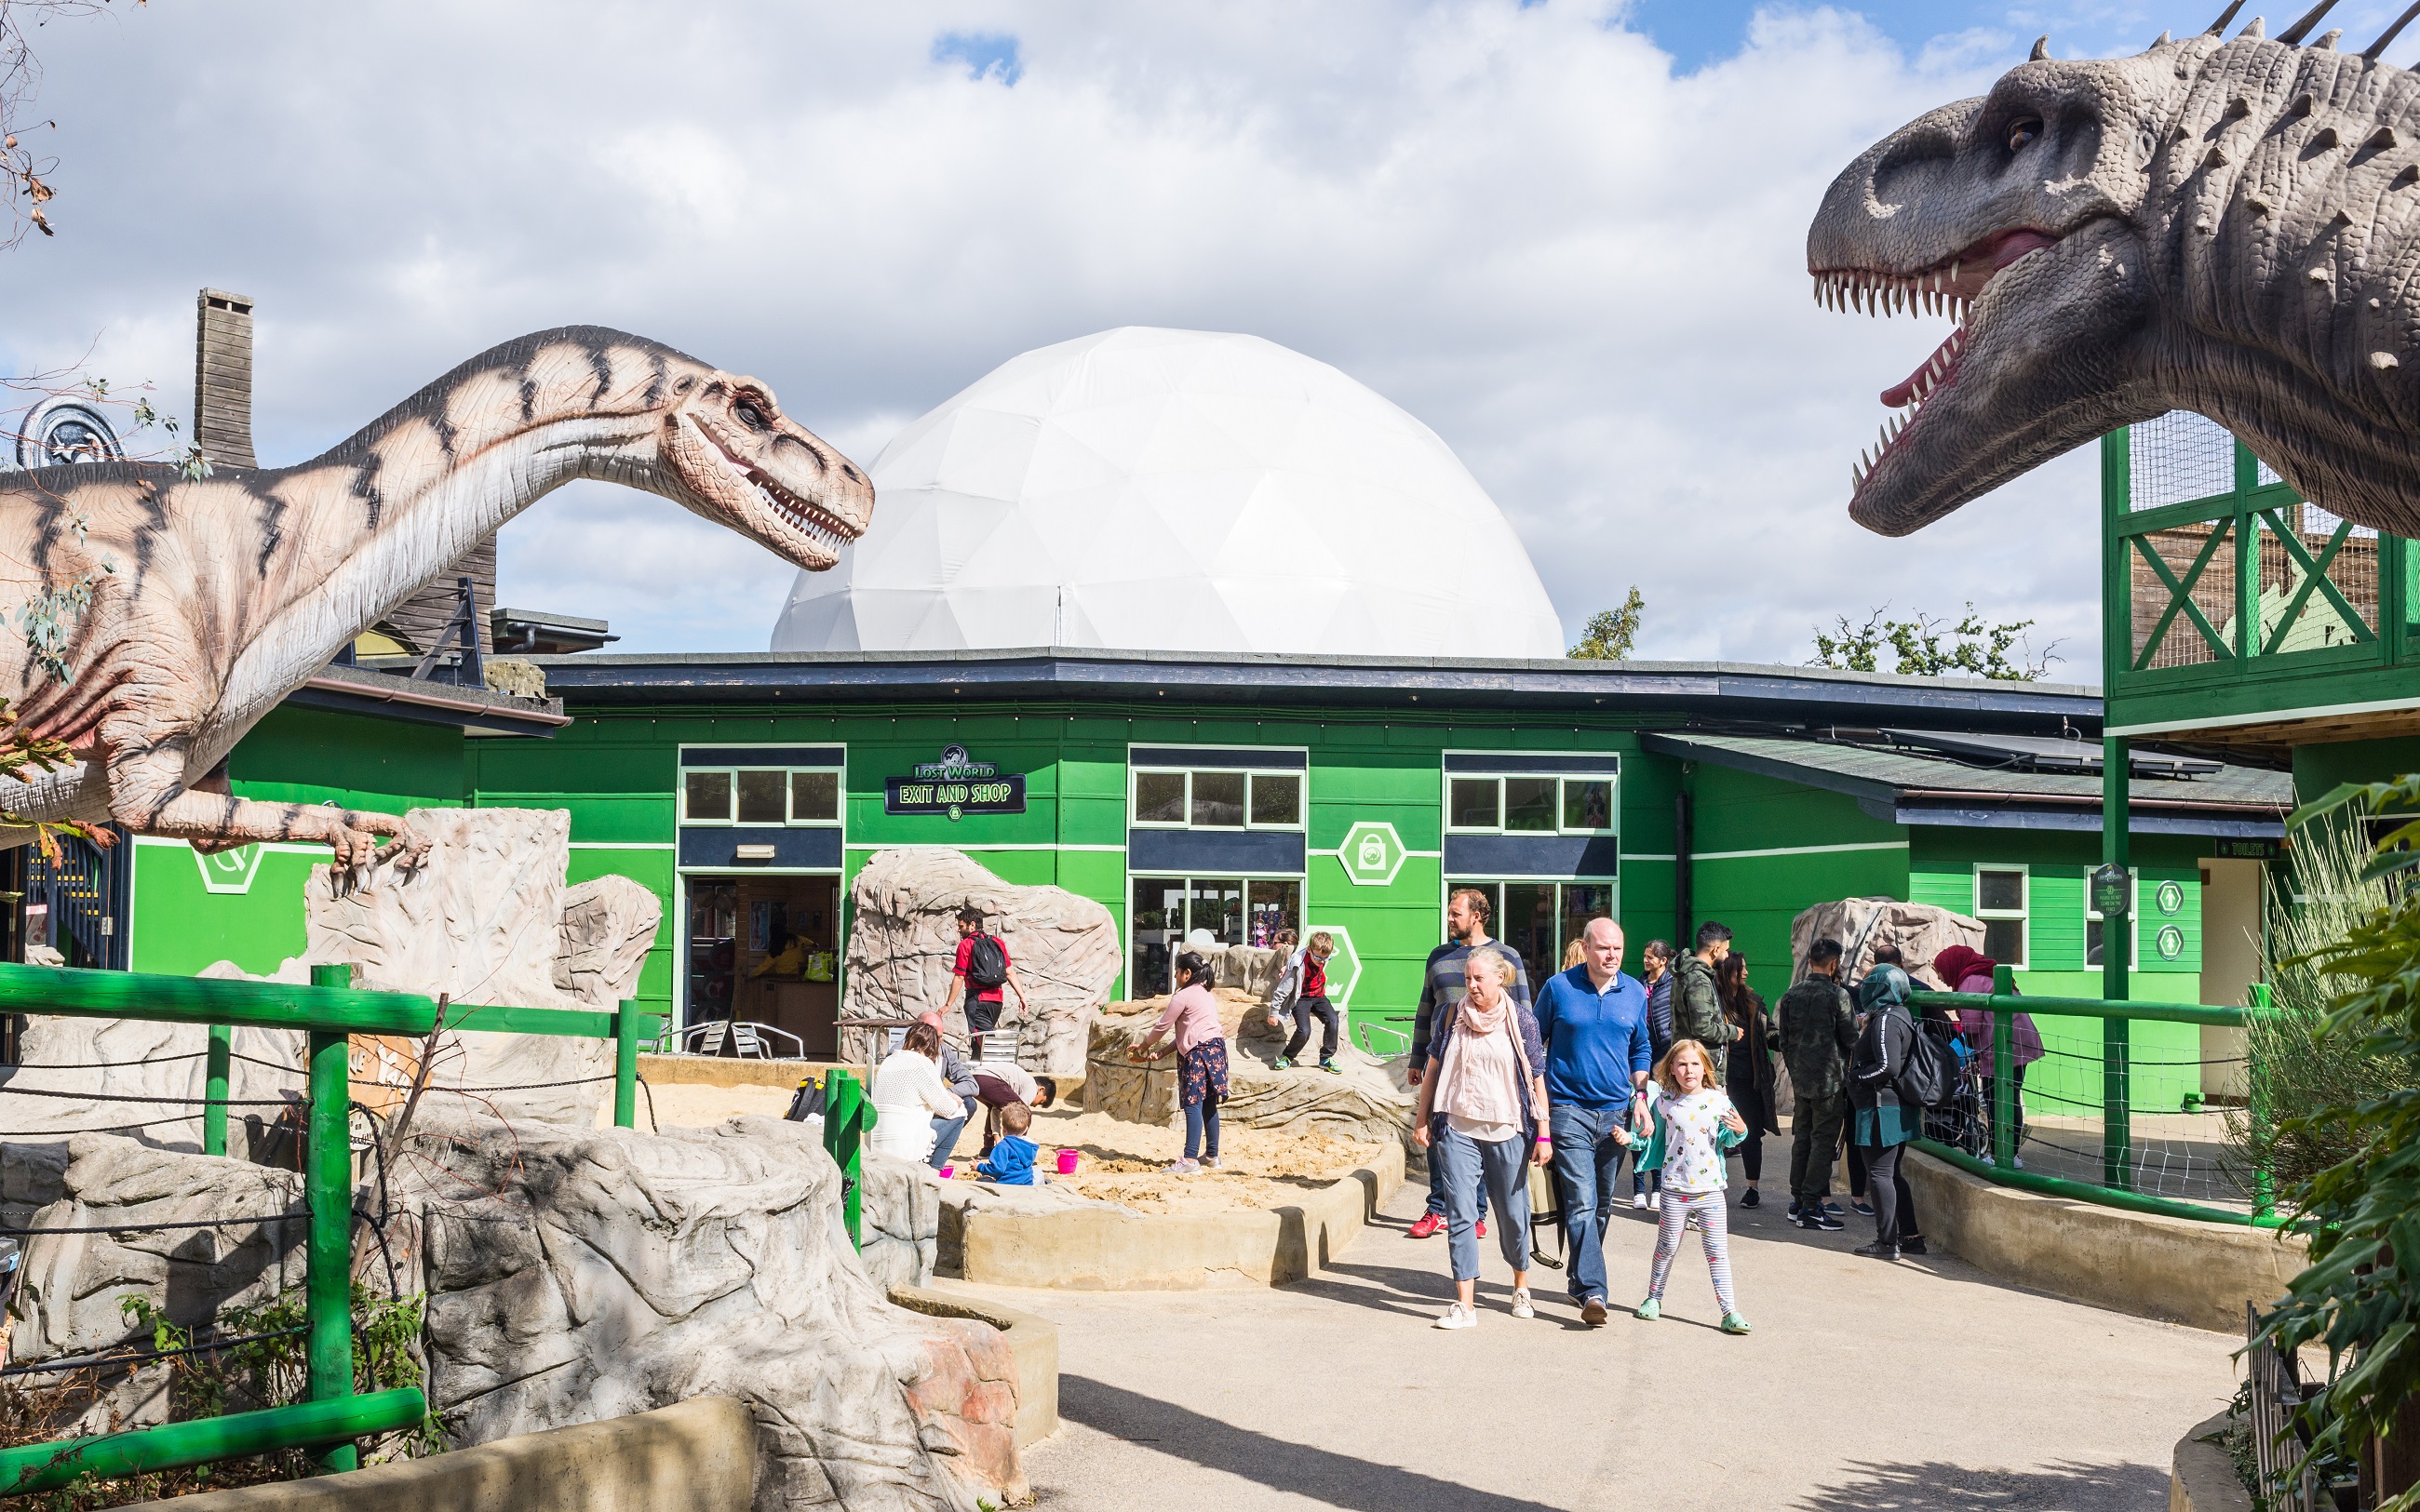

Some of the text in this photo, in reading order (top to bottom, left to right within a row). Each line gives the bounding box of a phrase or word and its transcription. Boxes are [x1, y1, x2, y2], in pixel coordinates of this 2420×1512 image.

[914, 766, 995, 780] LOST WORLD
[899, 783, 1011, 804] EXIT AND SHOP
[2232, 842, 2265, 856] TOILETS
